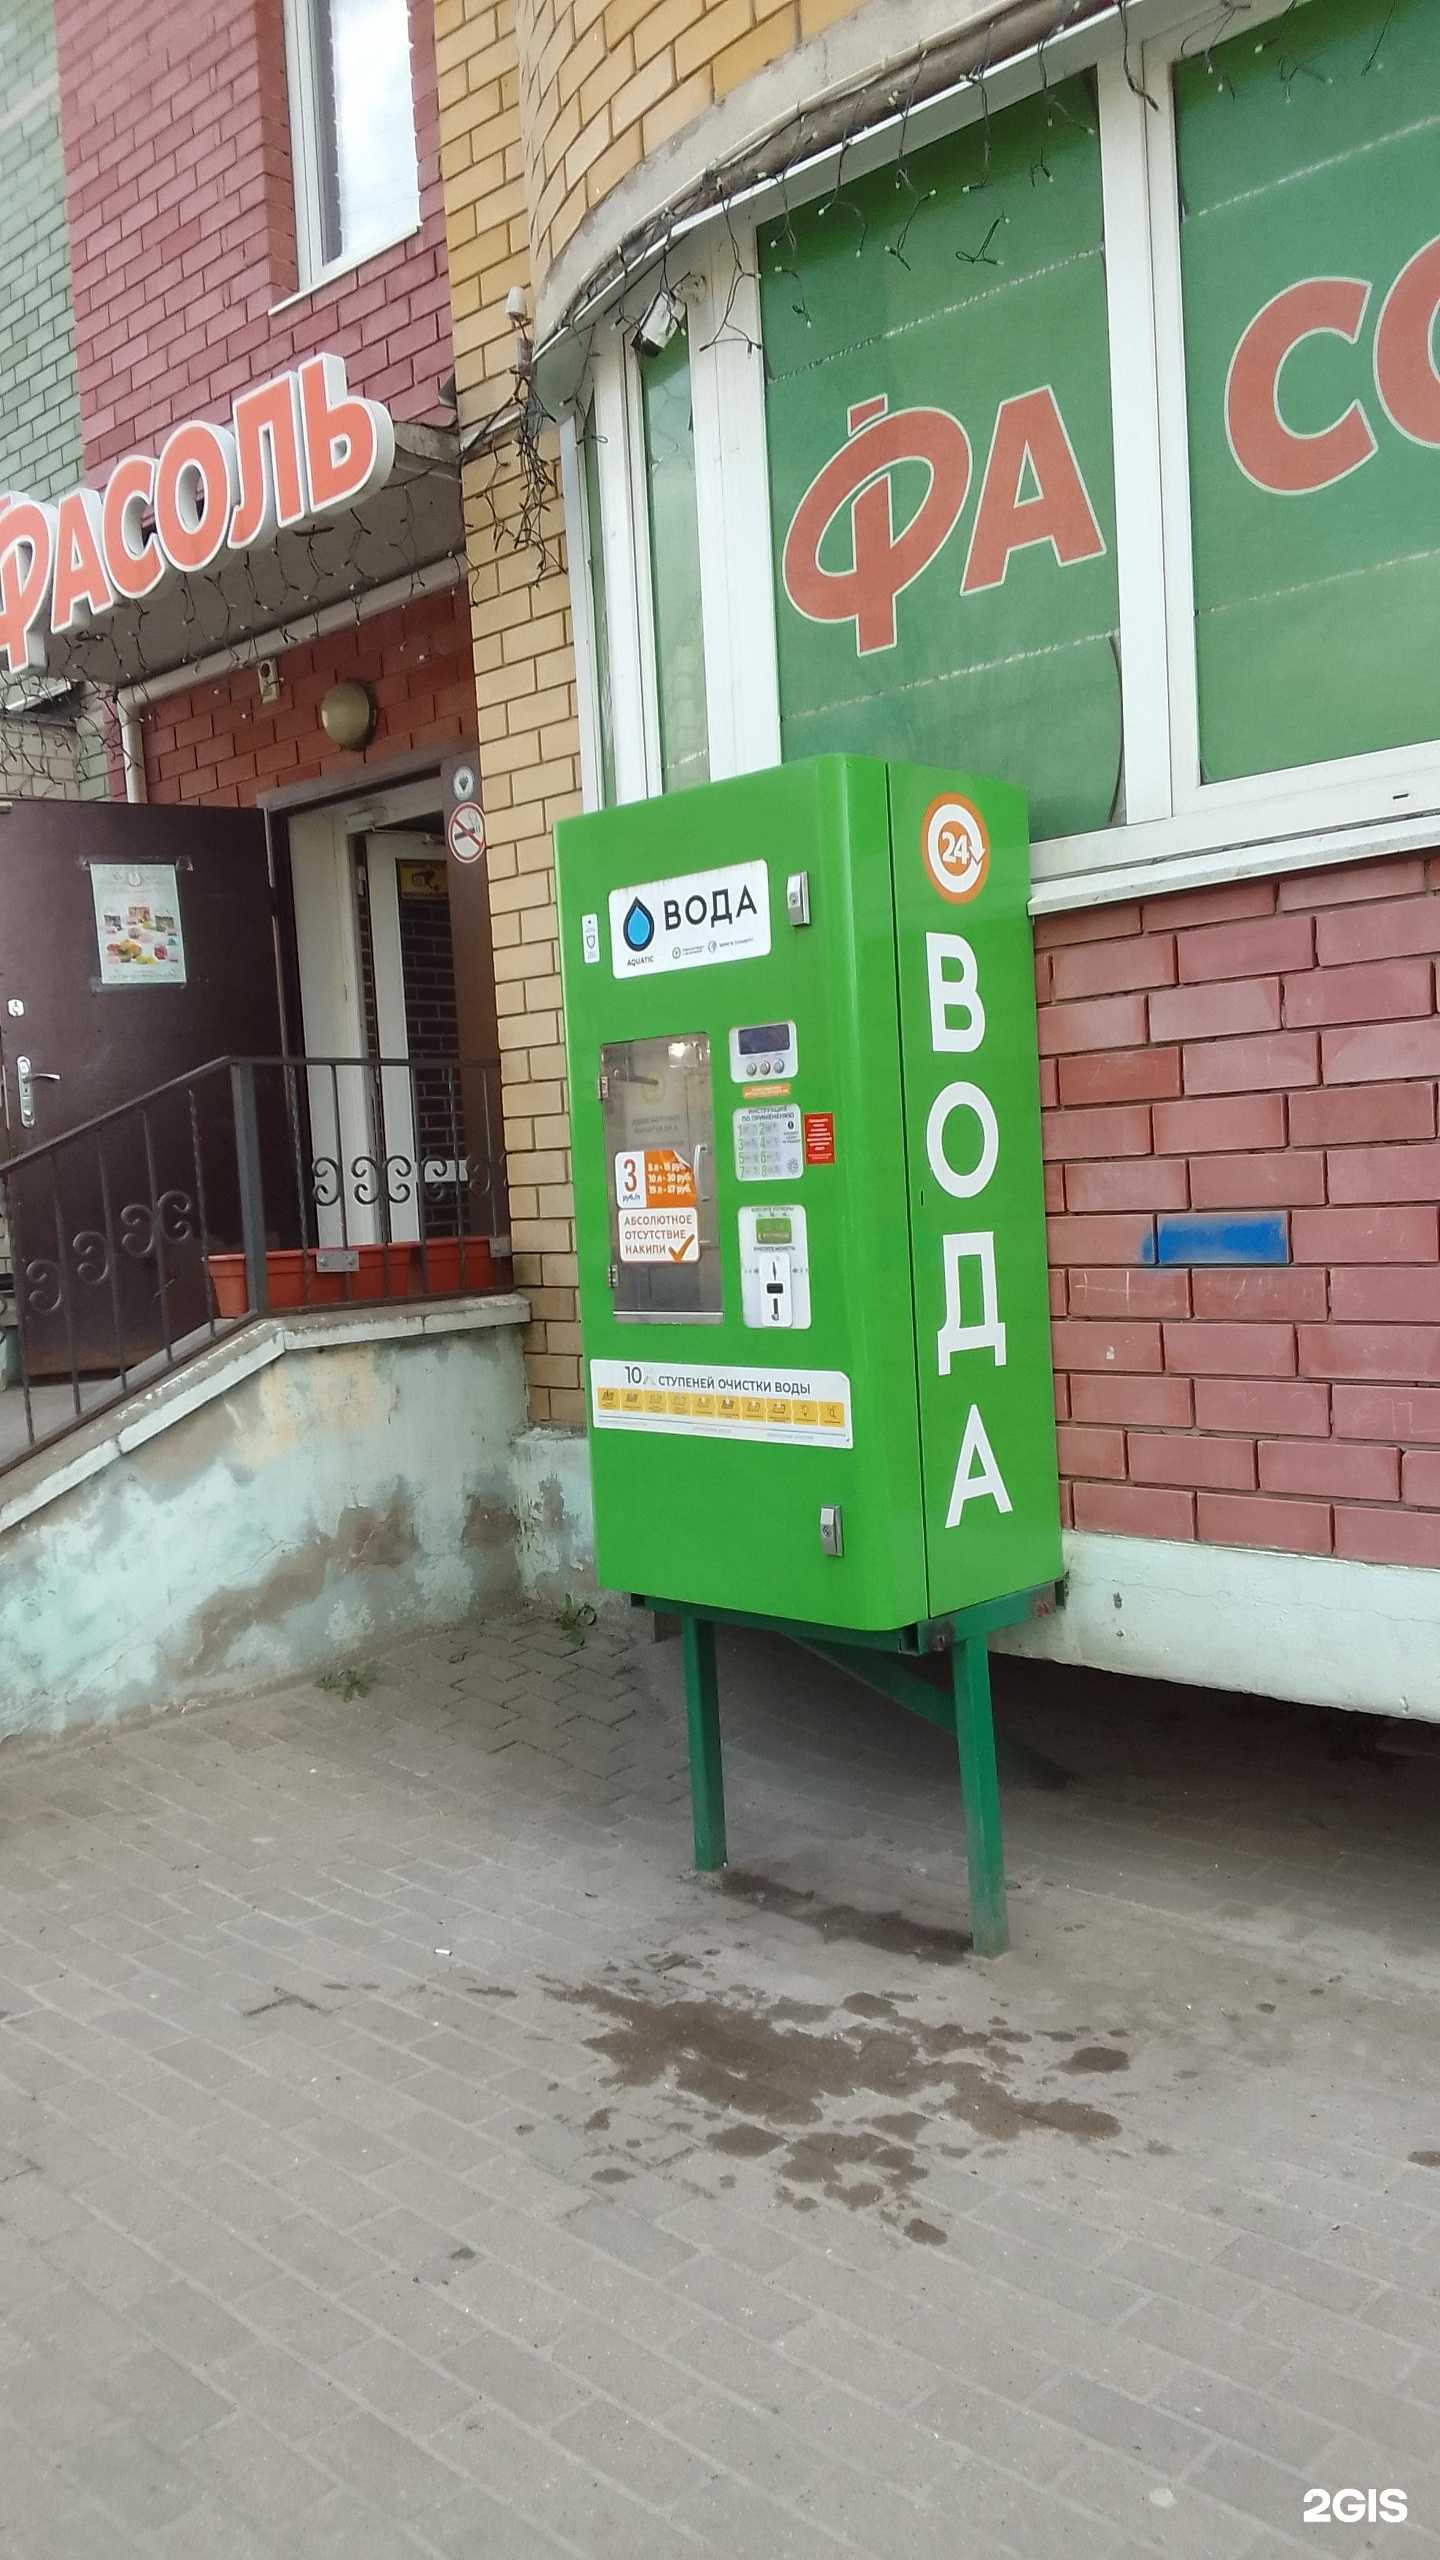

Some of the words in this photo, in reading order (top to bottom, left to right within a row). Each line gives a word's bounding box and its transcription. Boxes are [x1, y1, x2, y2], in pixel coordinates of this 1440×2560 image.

[0, 352, 392, 675] ФАСОЛЬ
[941, 831, 970, 865] 24
[664, 885, 757, 931] ВОДА
[626, 955, 654, 967] AQUATIC
[623, 1158, 637, 1193] 3
[624, 1214, 693, 1227] АБСОЛЮТНОЕ
[624, 1228, 688, 1241] ОТСУТСТВИЕ
[926, 932, 1013, 1528] ВОДА
[625, 1243, 667, 1255] НАКИПИ
[624, 1366, 642, 1384] 10
[658, 1374, 714, 1389] СТУПЕНЕЙ
[718, 1377, 771, 1392] ОЧИСТКИ
[775, 1381, 811, 1395] ВОДЫ
